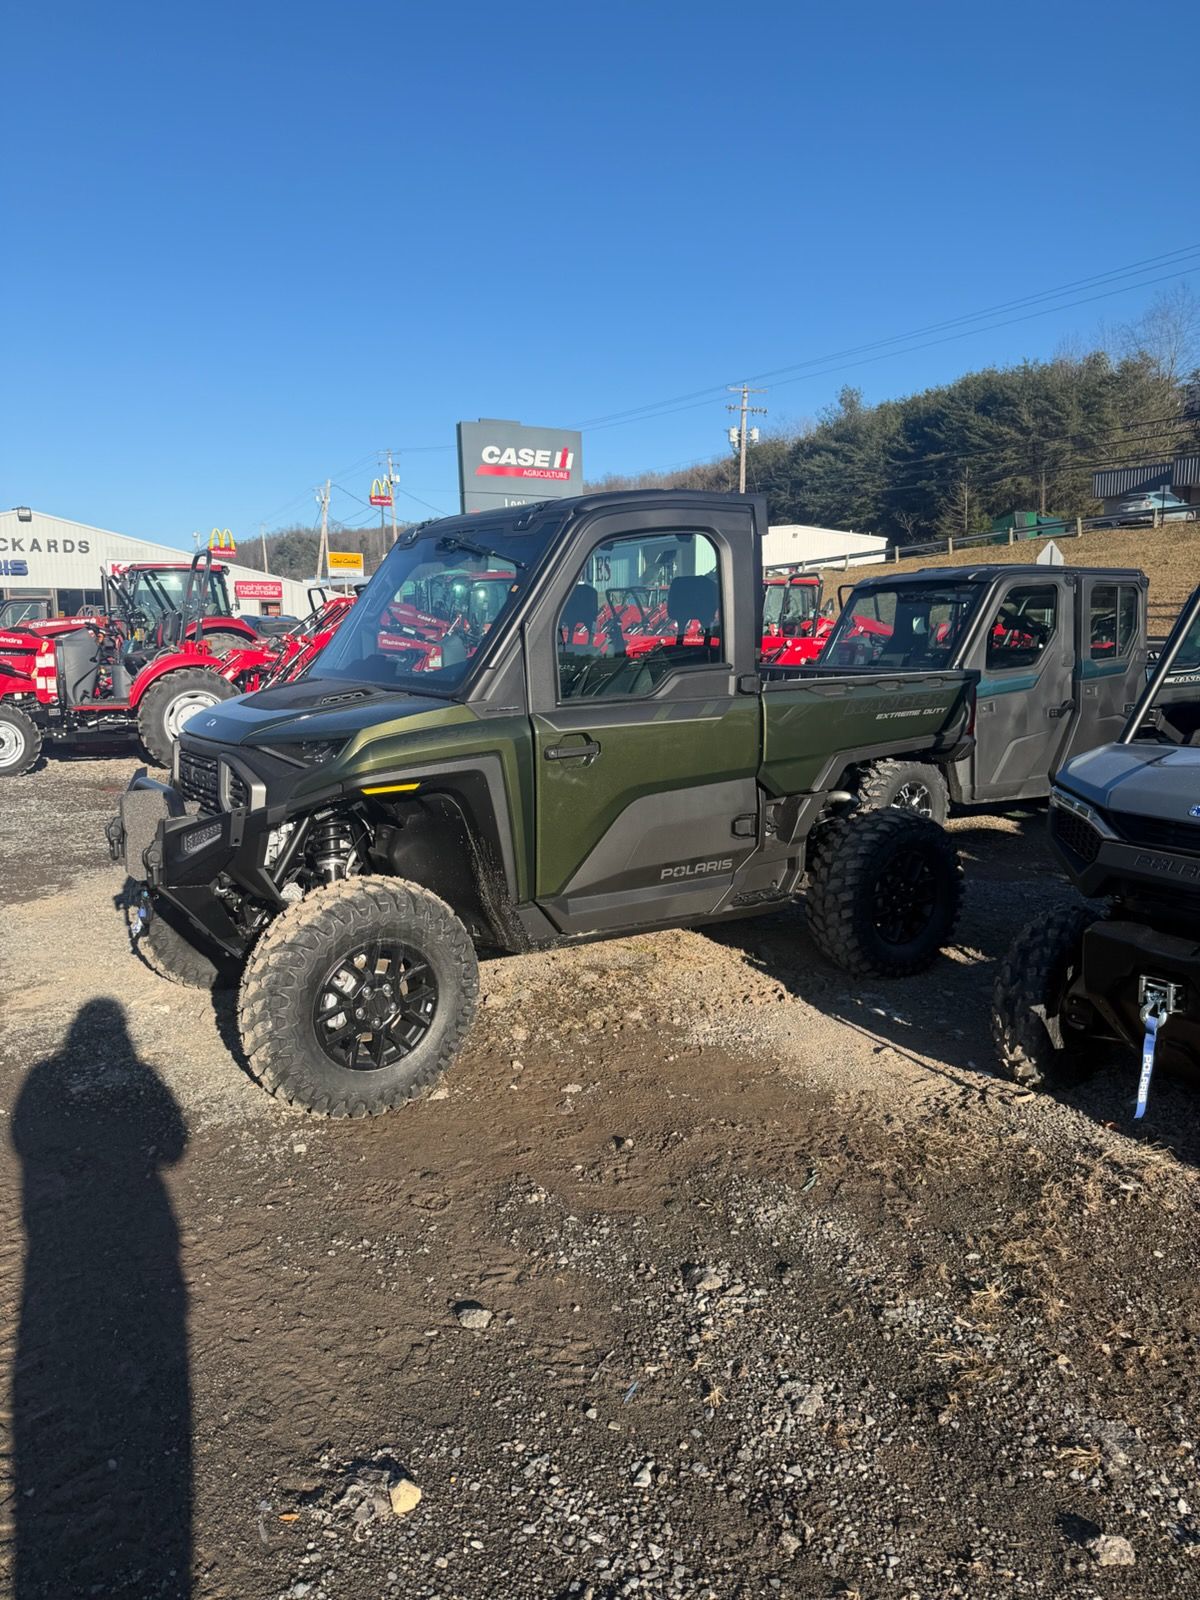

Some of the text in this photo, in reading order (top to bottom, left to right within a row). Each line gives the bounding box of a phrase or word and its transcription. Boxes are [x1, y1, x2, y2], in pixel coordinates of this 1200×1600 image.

[481, 445, 552, 468] CASE
[522, 469, 568, 479] AGRICULTURE
[0, 537, 91, 554] CKARDS
[0, 559, 28, 576] IS
[236, 584, 281, 592] mahindra
[875, 706, 948, 720] EXTREME DUTY
[659, 858, 734, 880] POLARIS
[1138, 1054, 1151, 1102] POLARIS
